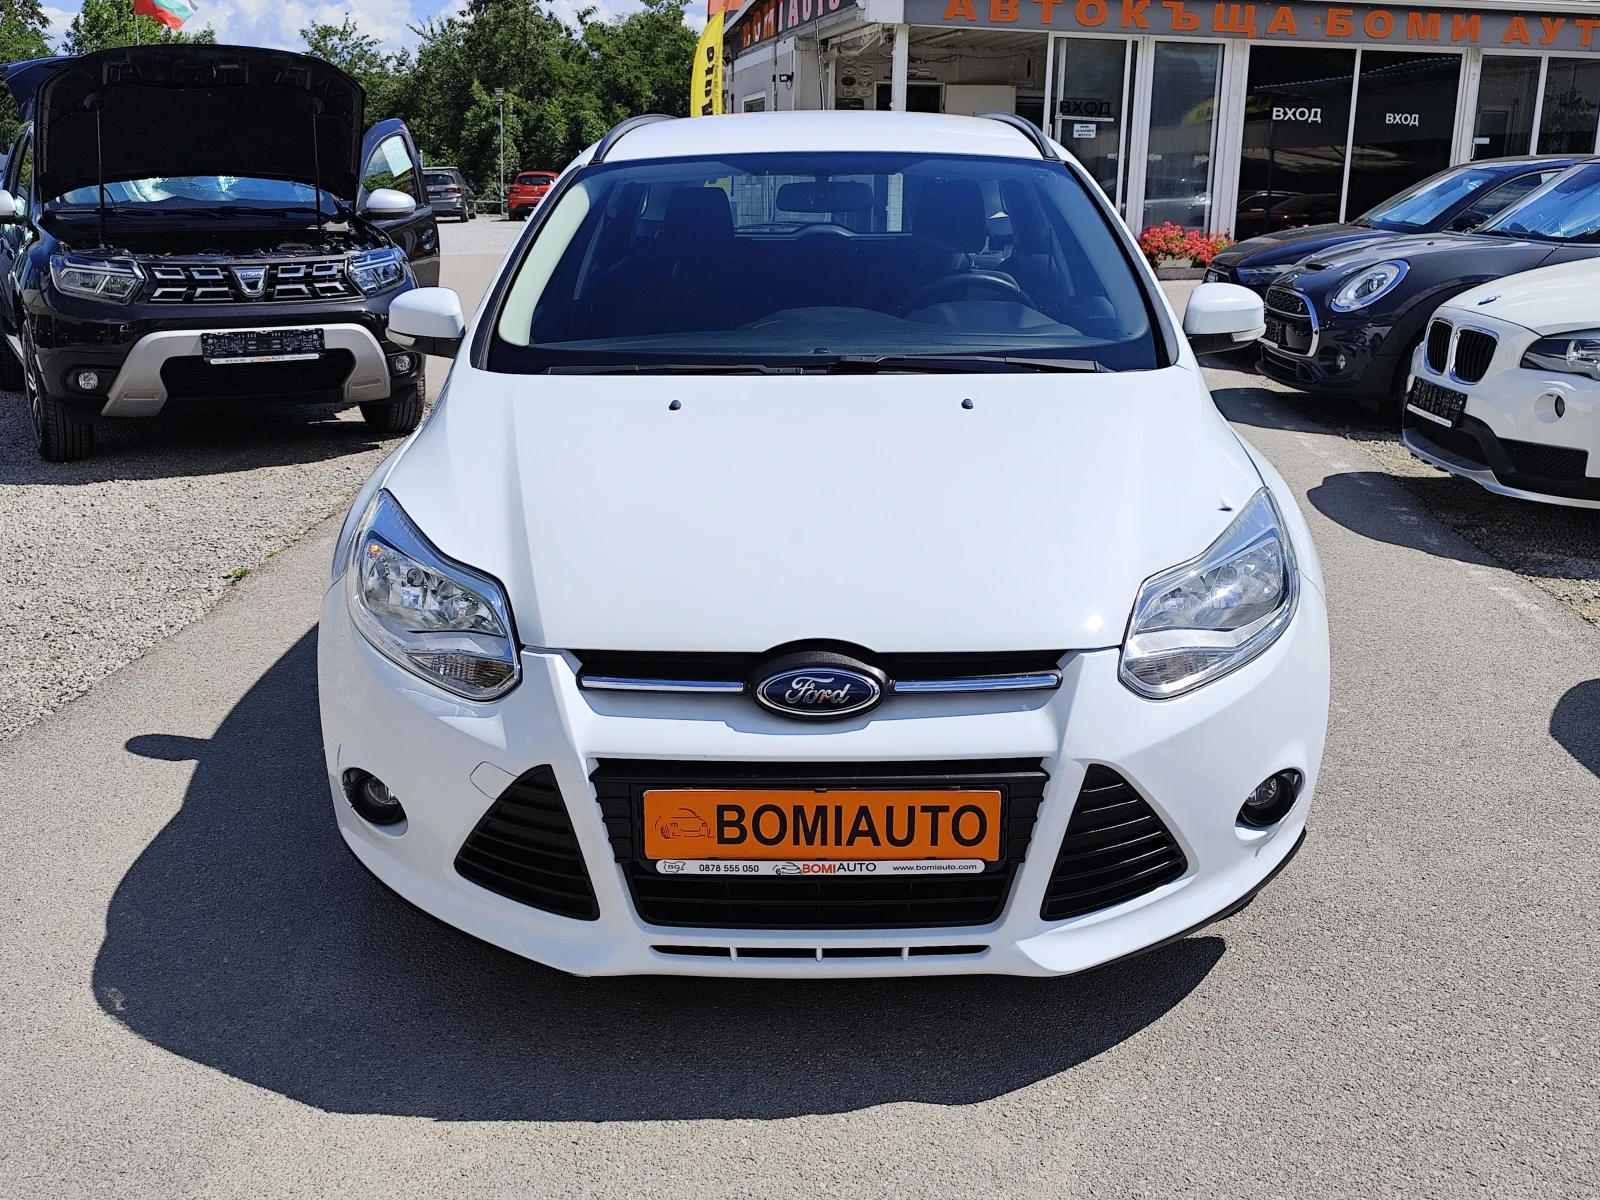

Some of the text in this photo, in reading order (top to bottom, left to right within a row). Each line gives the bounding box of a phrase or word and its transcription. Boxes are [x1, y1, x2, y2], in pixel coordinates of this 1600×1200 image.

[942, 0, 1298, 39] АВТОКЪЩА
[1325, 8, 1481, 42] БОМИ
[1060, 100, 1111, 117] ВХОД
[1272, 107, 1322, 123] ВХОД
[1385, 113, 1419, 127] ВХОД
[784, 676, 851, 704] Ford
[716, 804, 988, 848] BOMIAUTO
[699, 864, 721, 872] 0878
[723, 864, 740, 873] 555
[742, 864, 760, 873] 050
